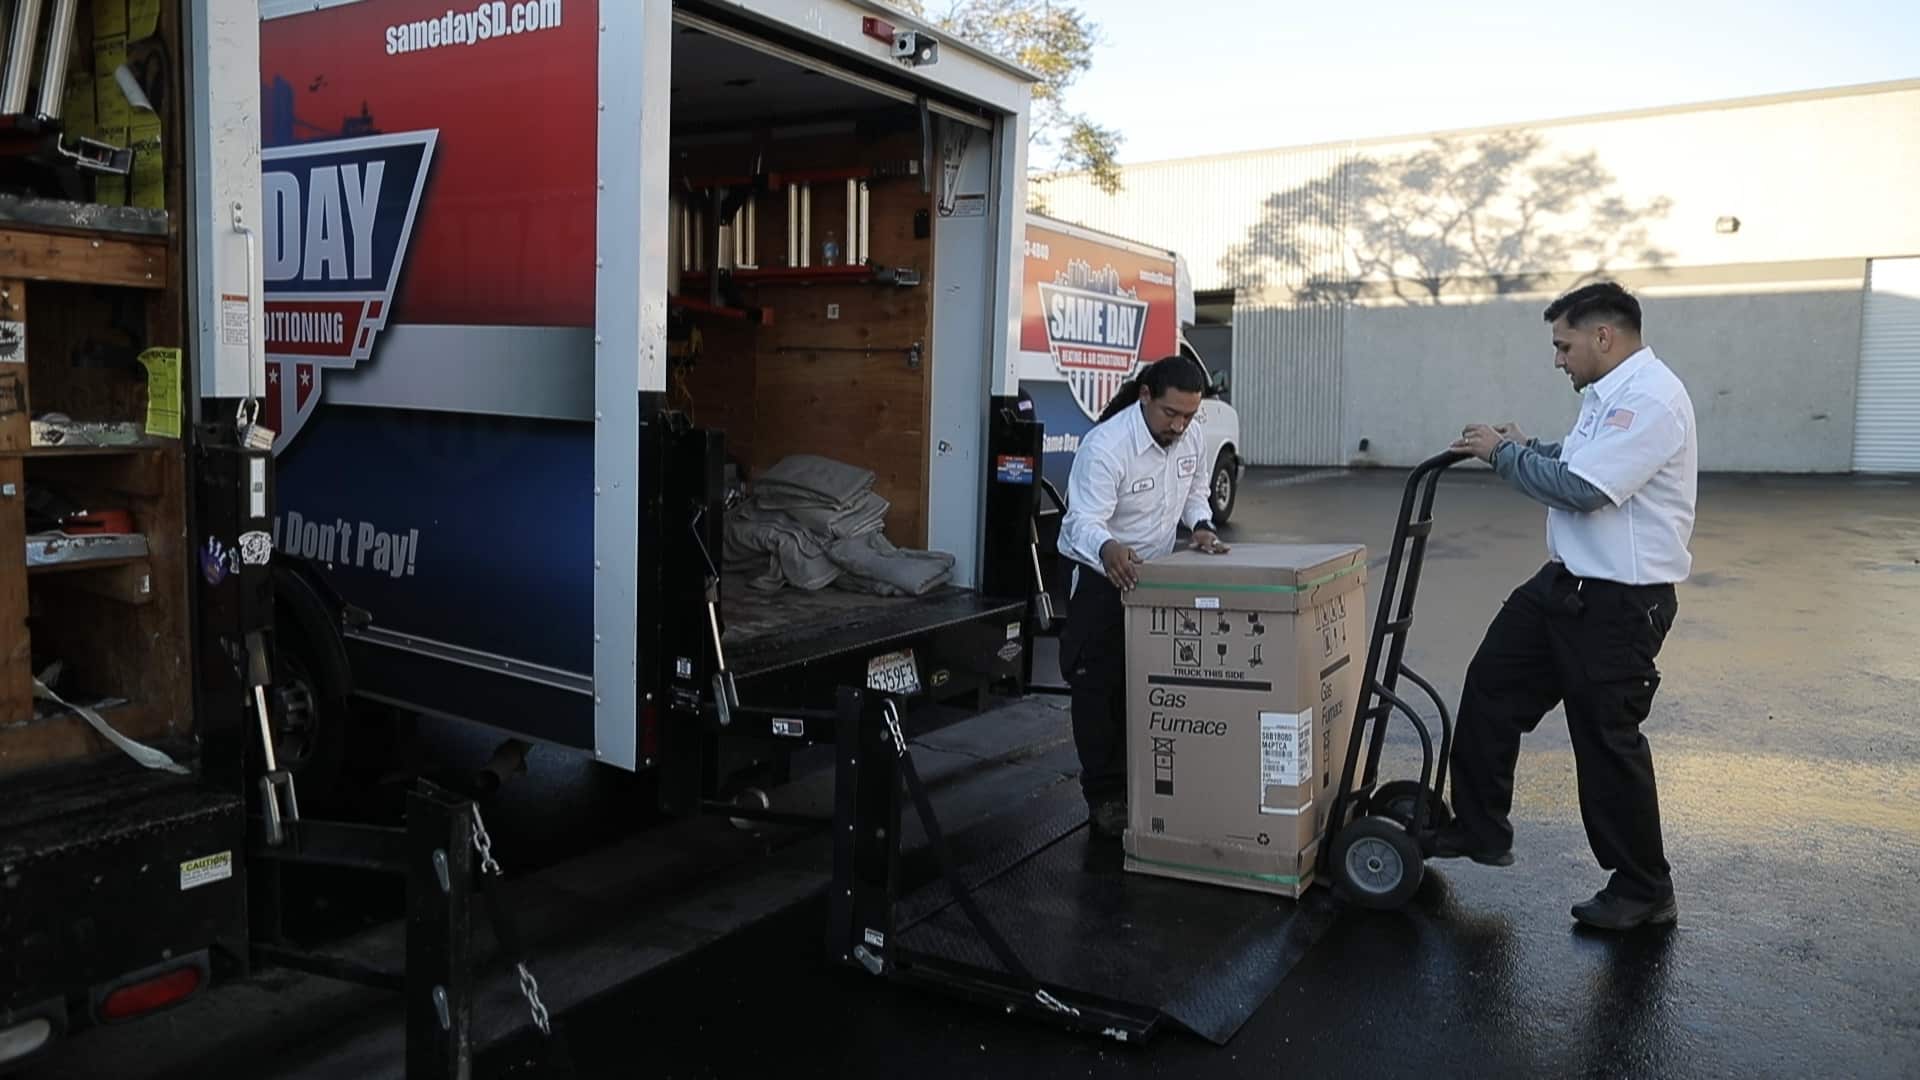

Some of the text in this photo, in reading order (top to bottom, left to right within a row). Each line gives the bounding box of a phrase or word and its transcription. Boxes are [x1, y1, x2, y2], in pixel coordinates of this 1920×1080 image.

[385, 0, 562, 55] samedaySD.com
[262, 160, 386, 281] DAY
[1051, 294, 1138, 347] SAME DAY
[285, 511, 352, 564] Don't
[356, 521, 419, 578] Pay!
[1173, 668, 1245, 680] TRUCK THIS SIDE
[1149, 687, 1187, 709] Gas
[1320, 681, 1333, 702] Gas
[1149, 711, 1228, 736] Furnace
[1321, 699, 1344, 728] Furnace
